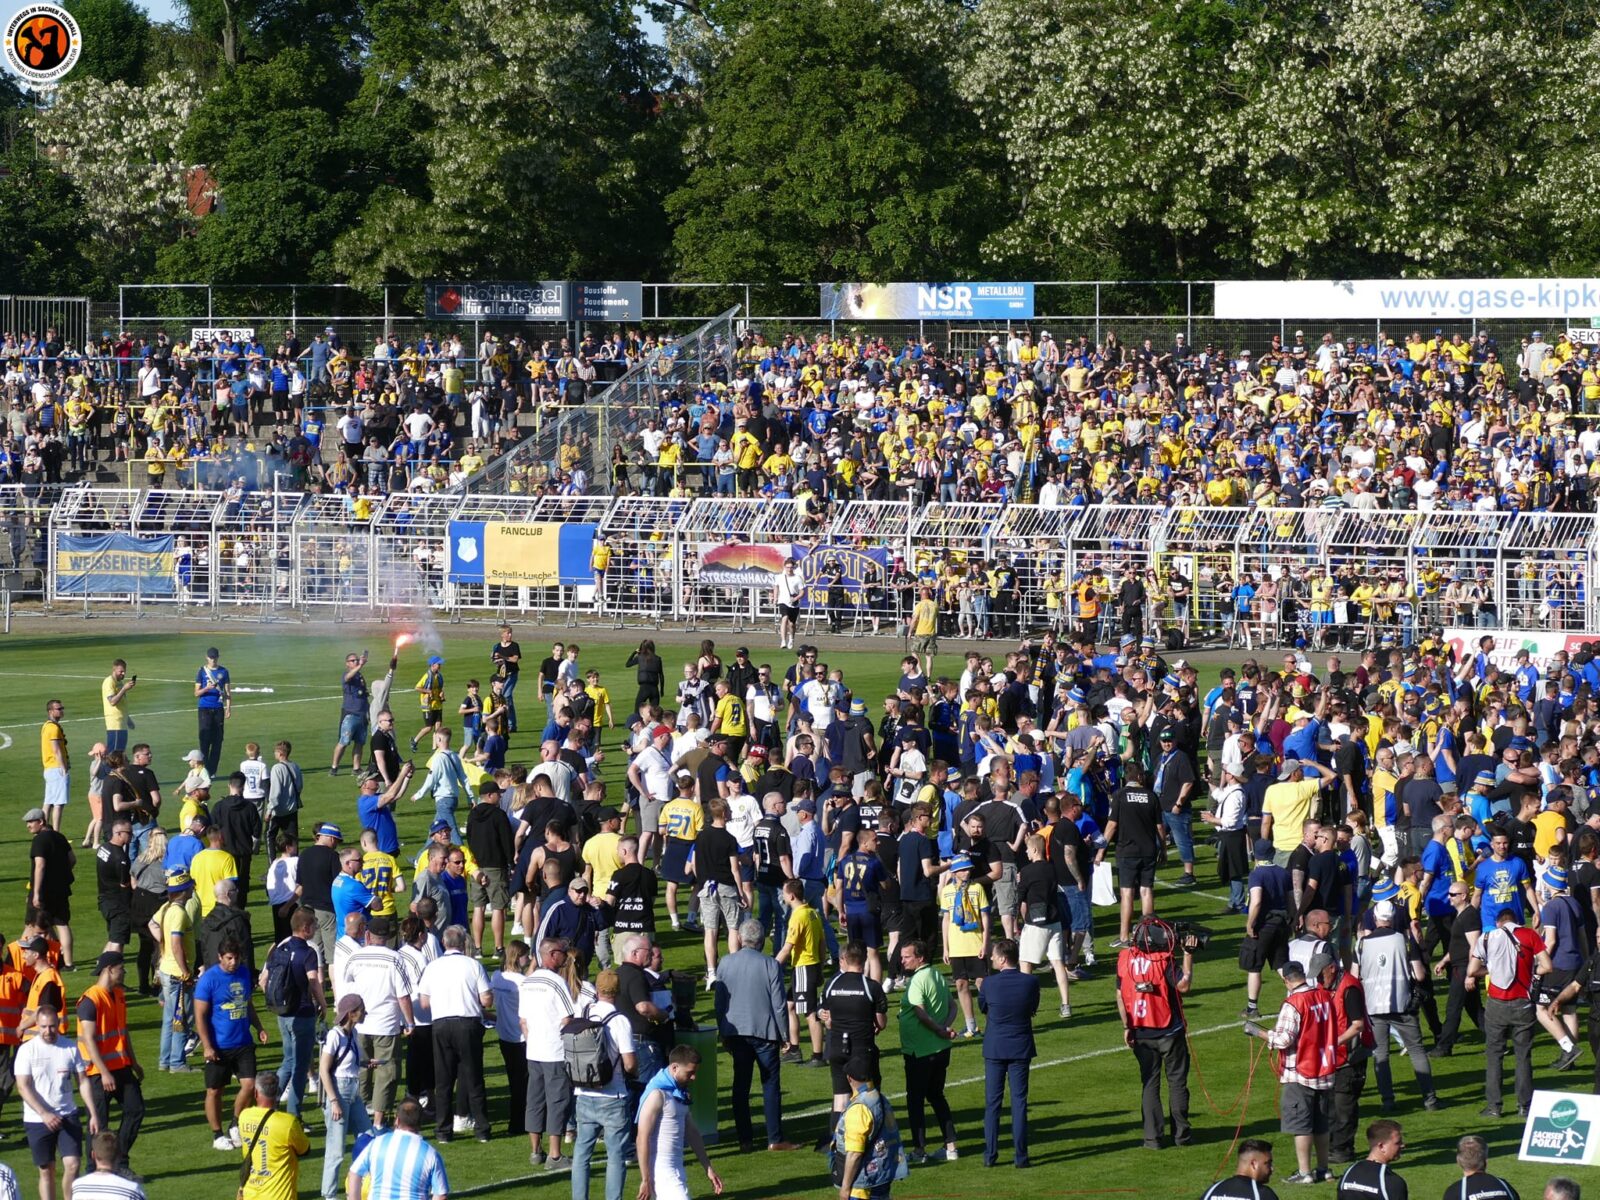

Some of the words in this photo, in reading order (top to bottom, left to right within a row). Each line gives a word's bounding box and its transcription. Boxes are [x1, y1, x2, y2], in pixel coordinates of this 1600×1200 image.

[465, 285, 561, 304] Rothkegel
[584, 285, 617, 294] Baustoffe
[977, 286, 1024, 296] METALLBAU
[584, 297, 629, 306] Bauelemente
[918, 286, 973, 310] NSR
[1380, 283, 1600, 315] www.gase-kipk
[467, 302, 482, 314] für
[485, 302, 505, 314] alle
[508, 302, 525, 314] die
[528, 302, 560, 314] bauen
[584, 308, 608, 316] Fliesen
[500, 526, 543, 536] FANCLUB
[1471, 637, 1518, 650] GEIF
[667, 814, 691, 836] 21
[1130, 956, 1152, 976] TV
[1309, 1001, 1330, 1023] TV
[242, 1122, 269, 1137] LEIPIG
[1533, 1130, 1564, 1140] SACHSEN
[1530, 1139, 1562, 1149] POKAL
